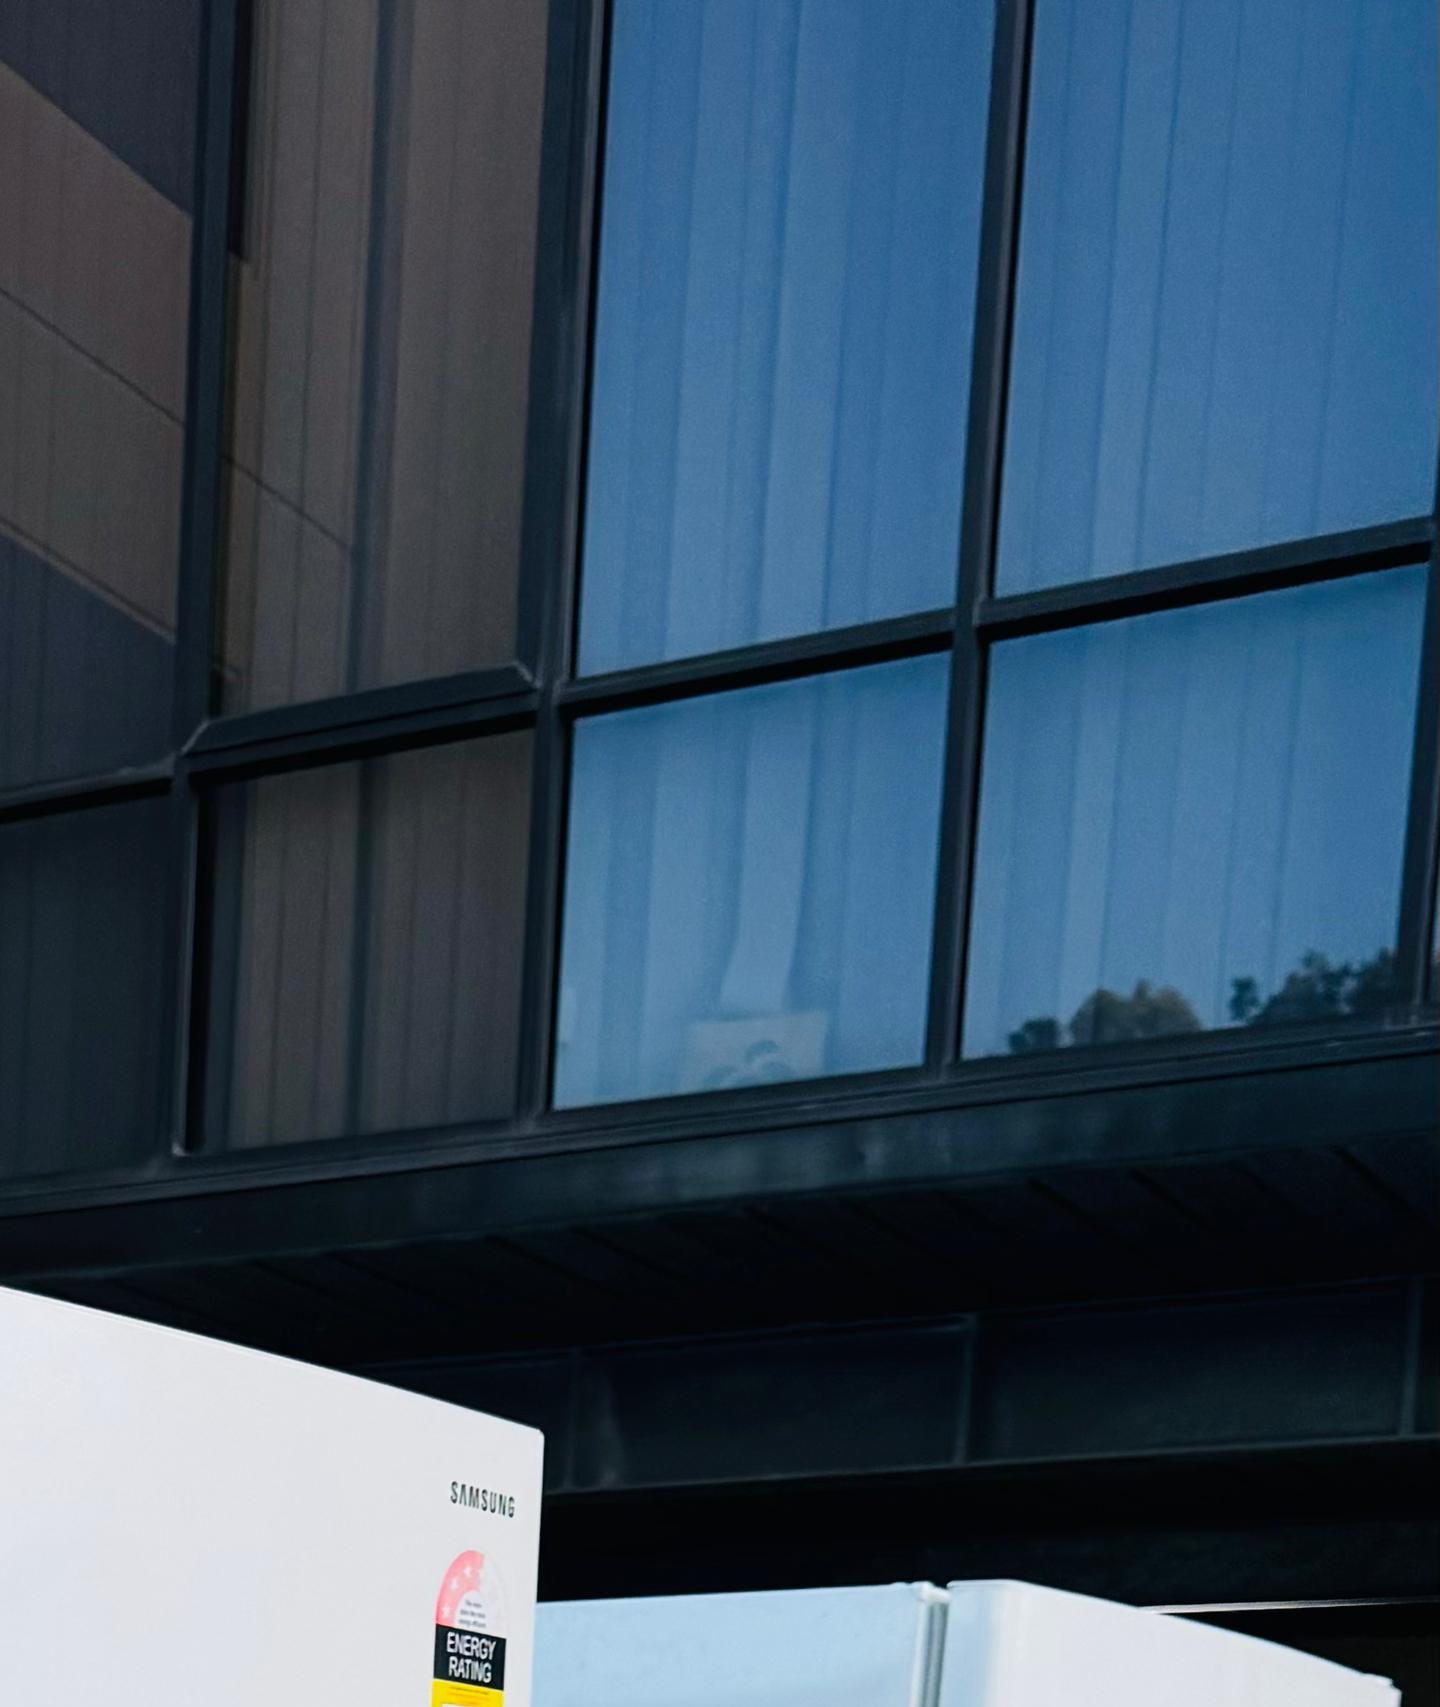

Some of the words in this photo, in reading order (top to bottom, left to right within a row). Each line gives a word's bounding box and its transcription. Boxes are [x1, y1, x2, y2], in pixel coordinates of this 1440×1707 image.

[450, 1481, 515, 1518] SAMSUNG
[447, 1631, 497, 1660] ENERGY
[448, 1655, 492, 1684] RATING
